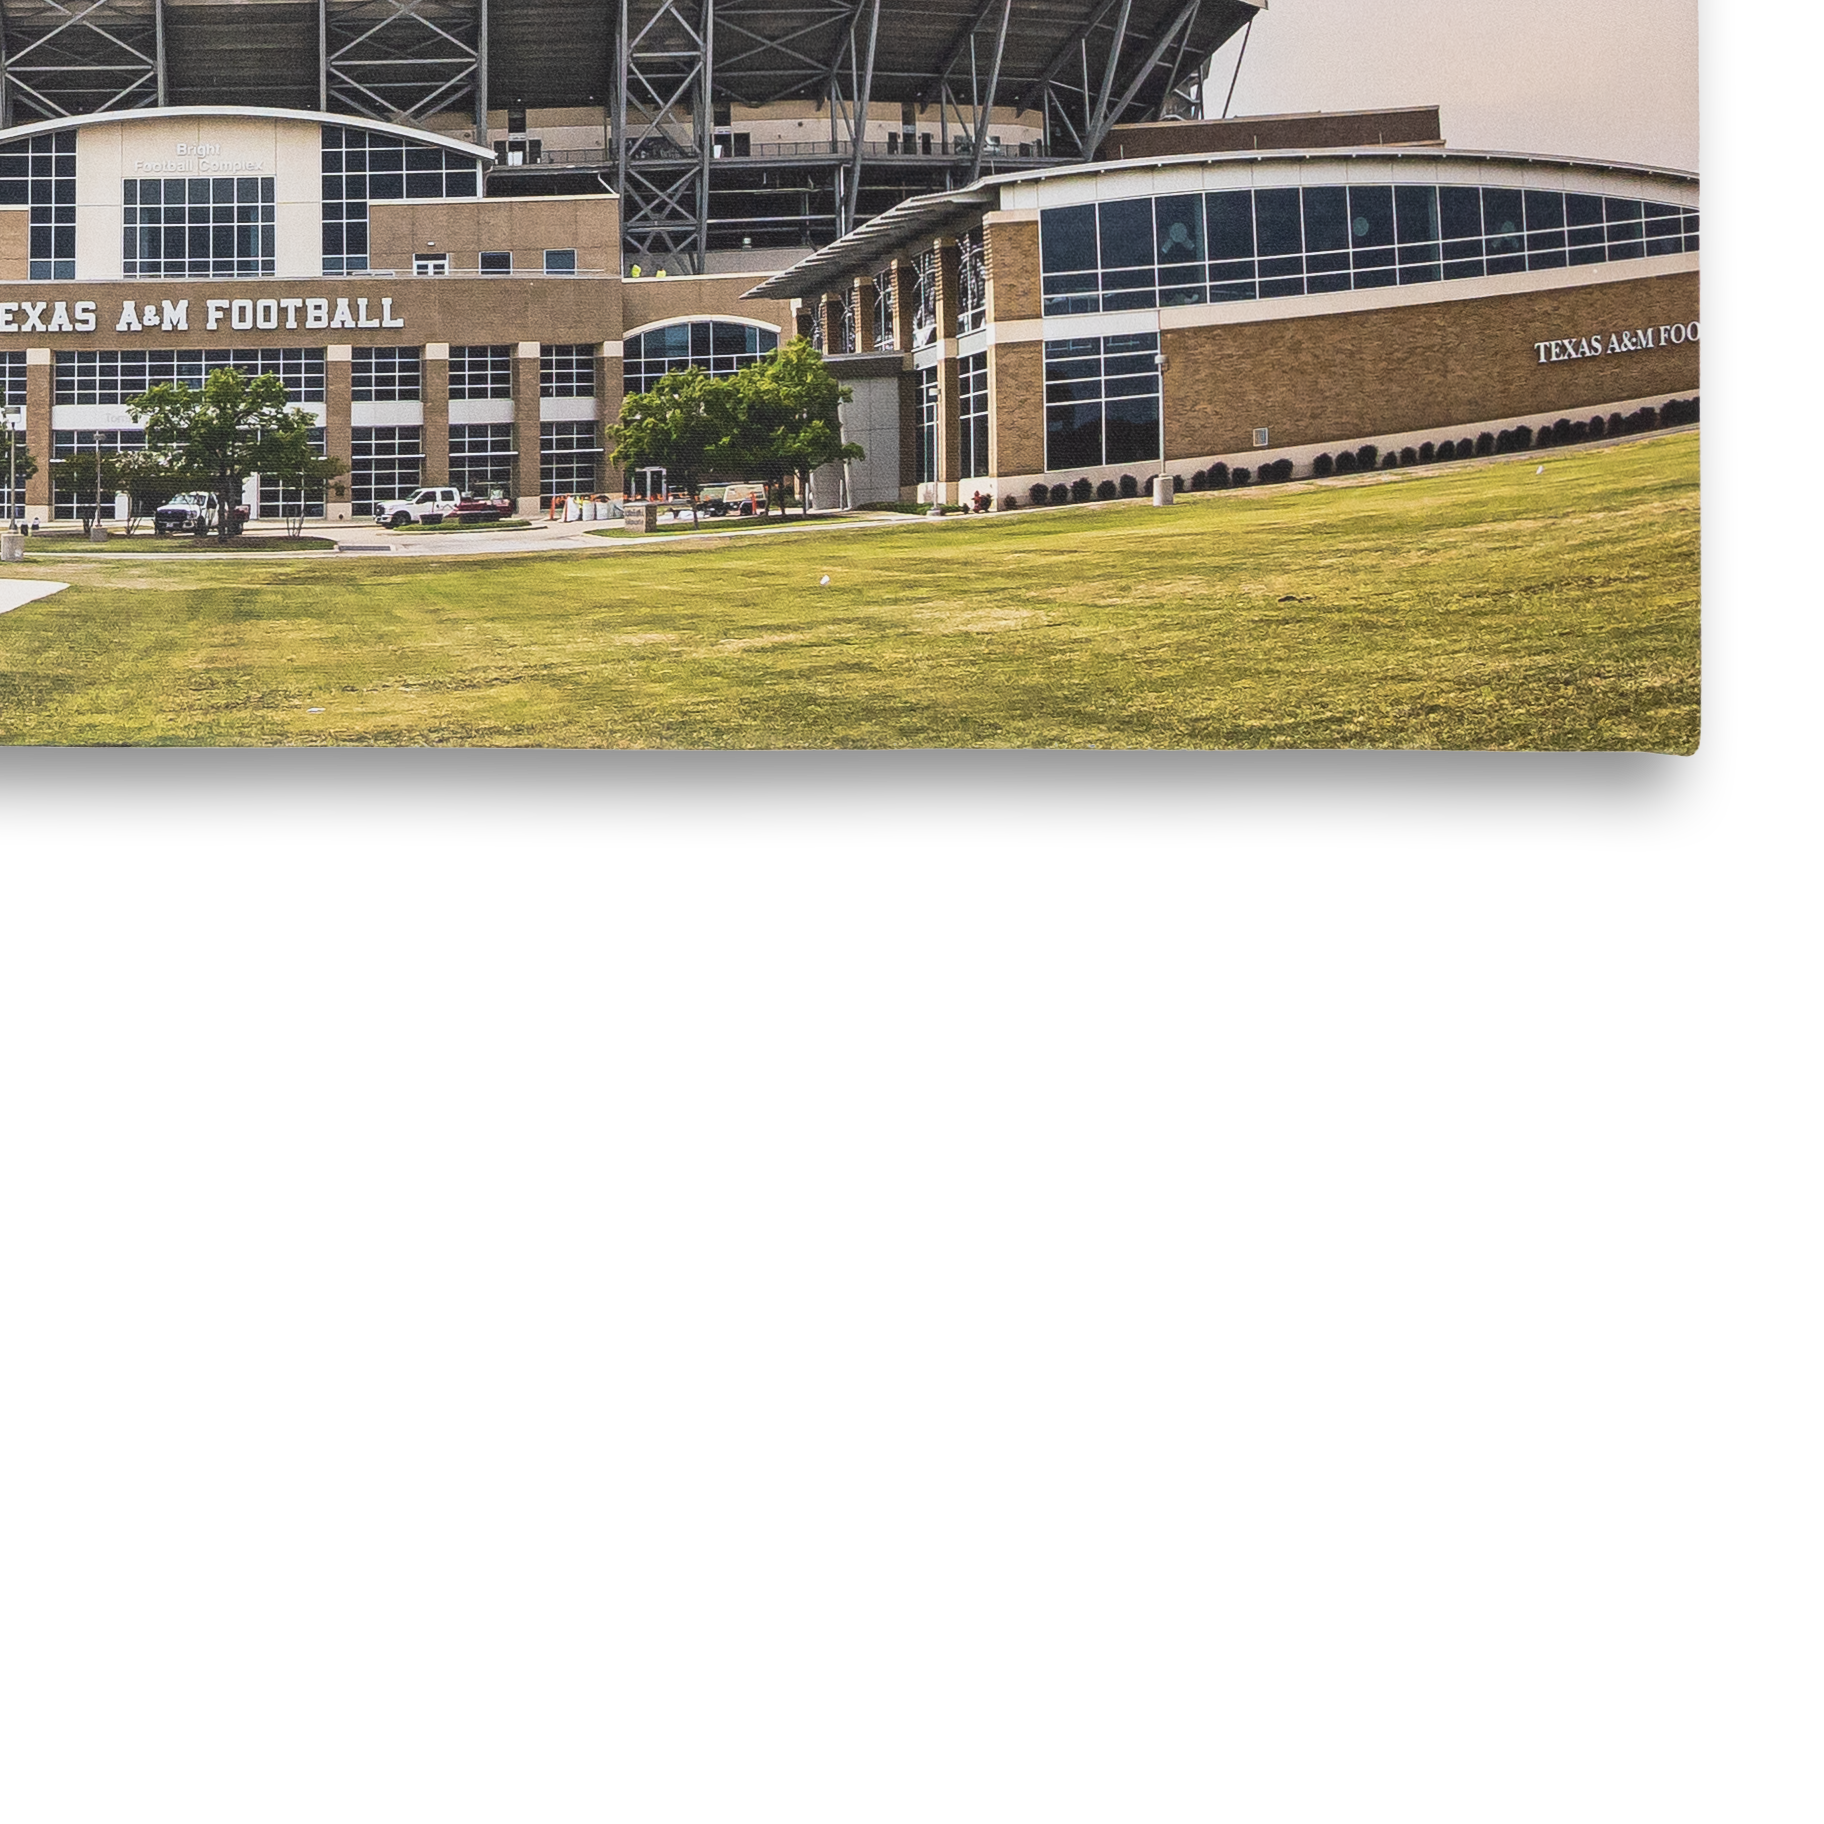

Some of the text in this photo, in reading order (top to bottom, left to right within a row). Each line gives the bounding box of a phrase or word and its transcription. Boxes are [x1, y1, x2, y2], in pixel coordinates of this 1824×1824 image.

[176, 143, 221, 157] Bright
[134, 160, 264, 174] Football Complex
[115, 299, 189, 332] A&M
[205, 297, 405, 331] FOOTBALL
[1534, 334, 1602, 363] TEXAS
[1606, 327, 1655, 354] A&M
